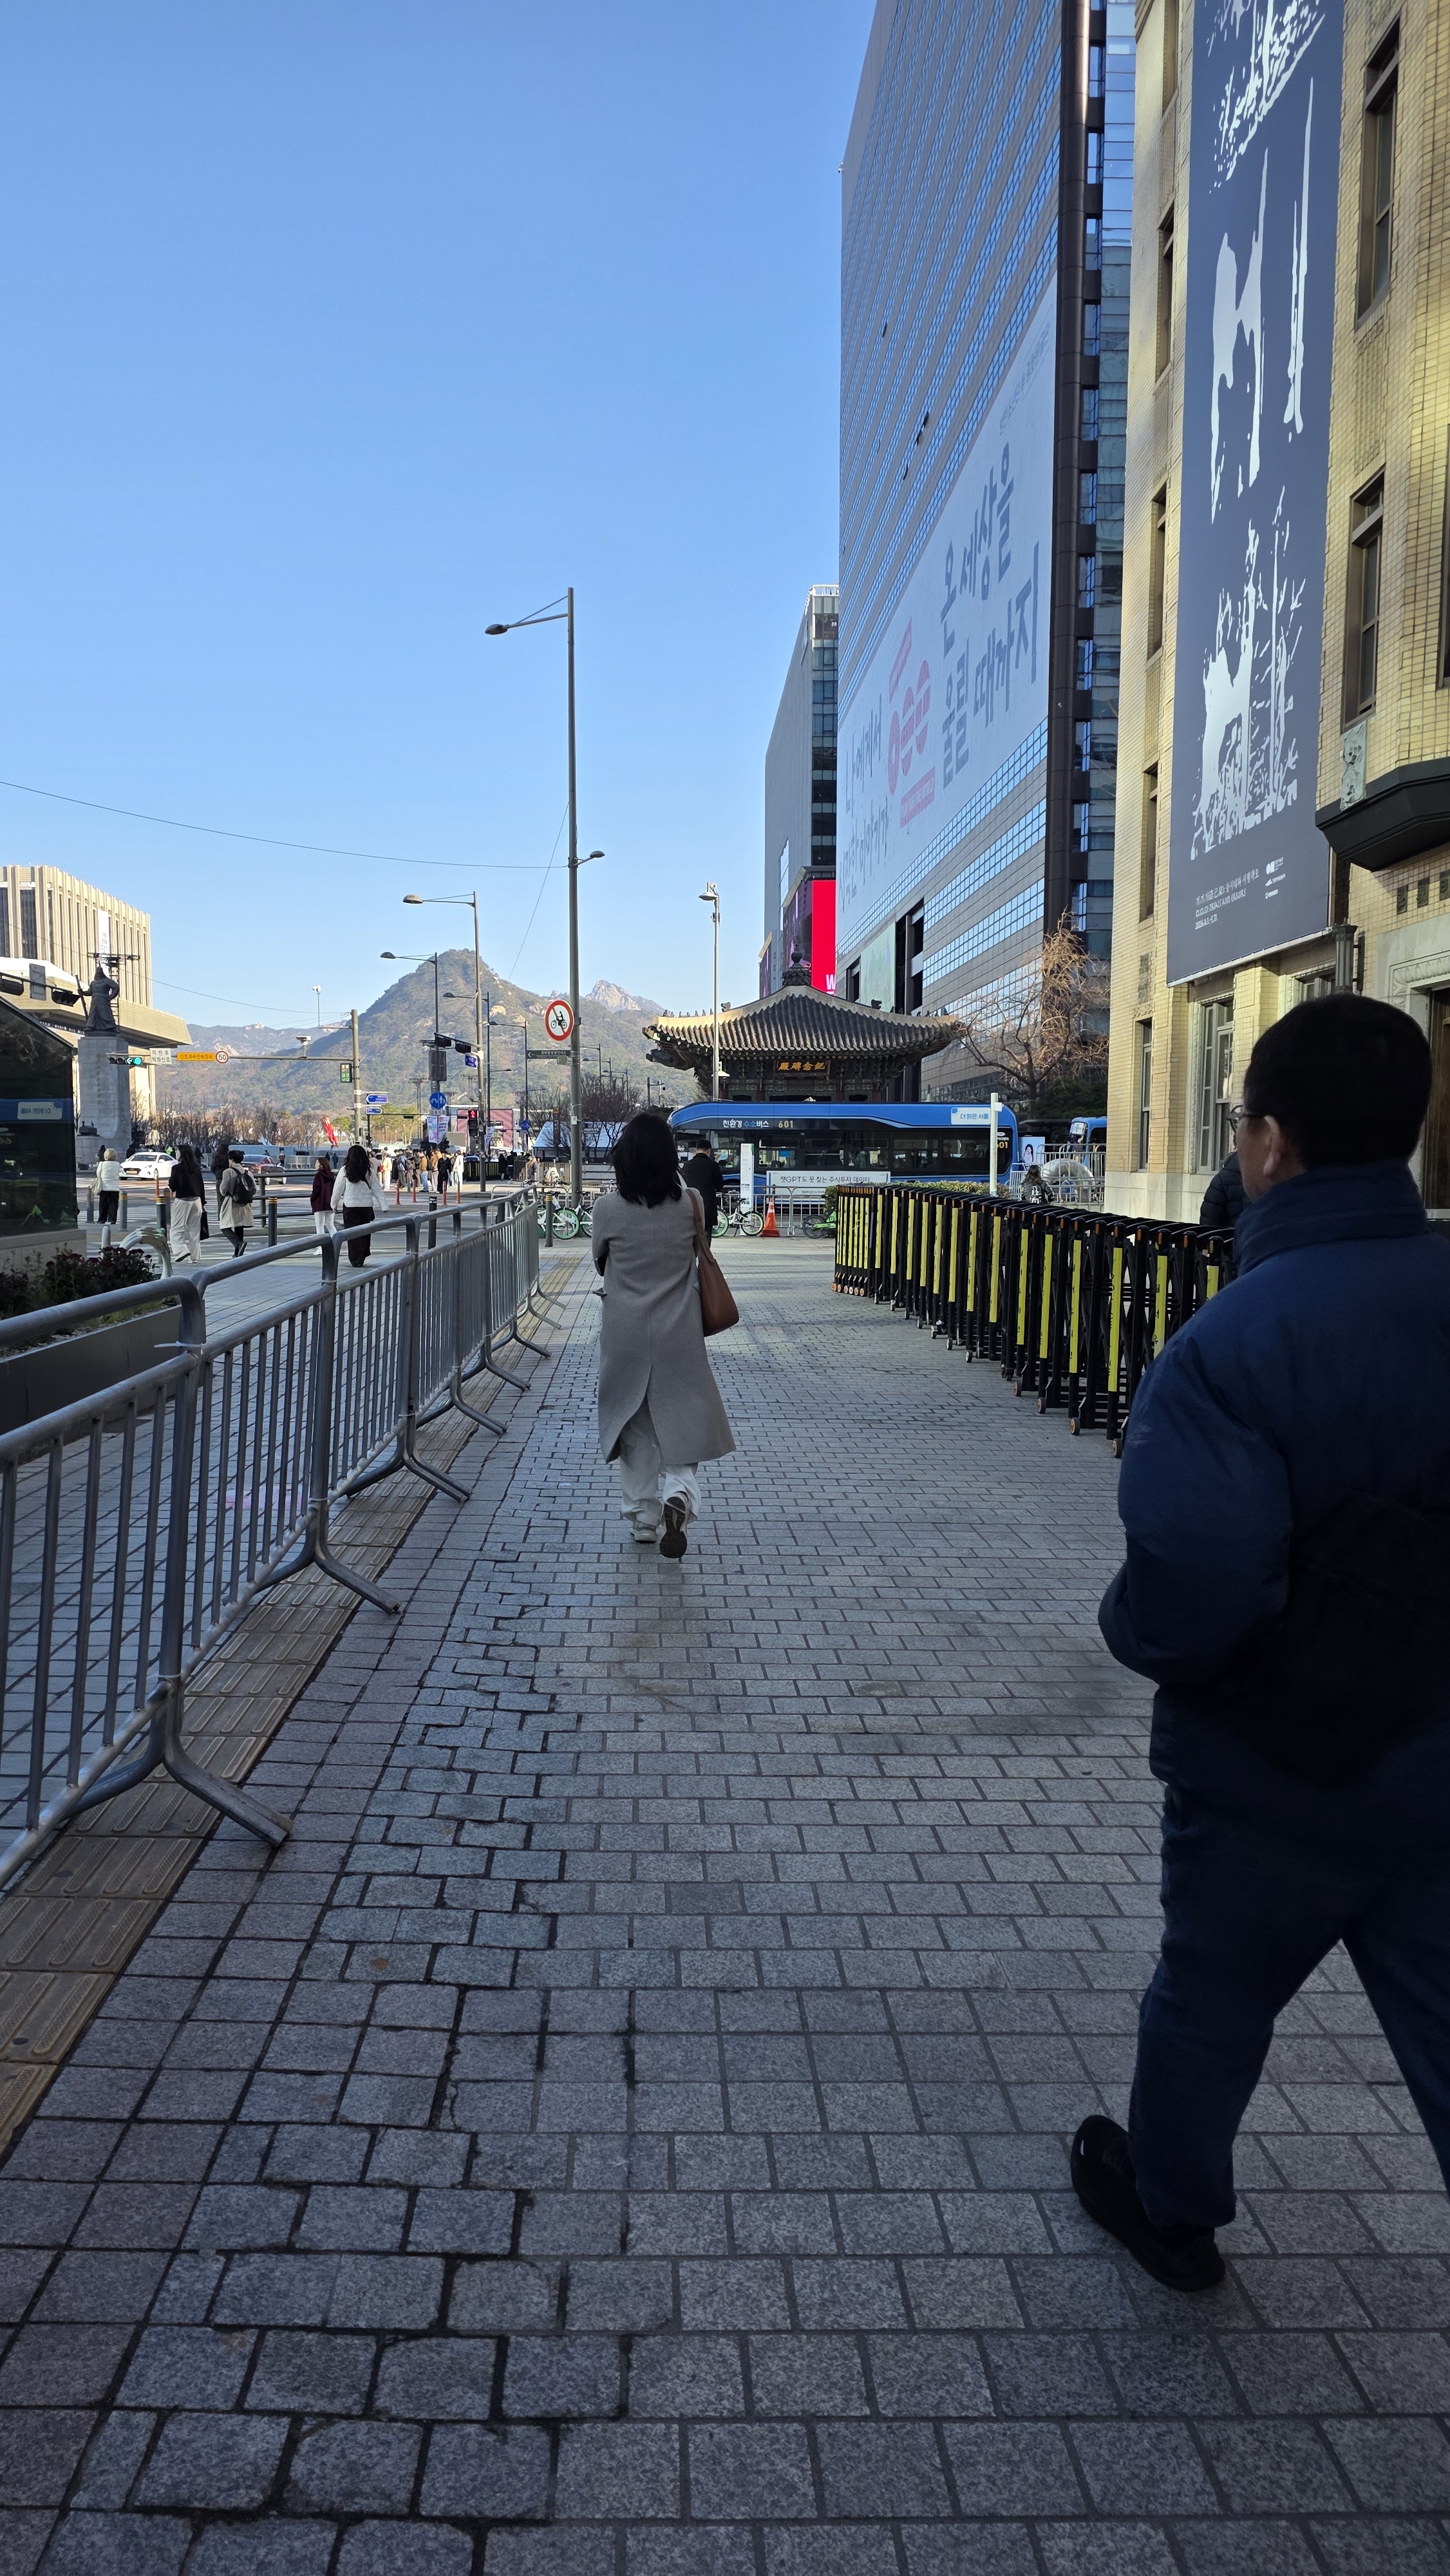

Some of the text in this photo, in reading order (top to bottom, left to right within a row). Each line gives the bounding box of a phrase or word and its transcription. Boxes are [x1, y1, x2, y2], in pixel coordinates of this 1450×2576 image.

[941, 441, 1015, 659] 온 세상을
[943, 540, 1039, 791] 울릴 때까지
[845, 693, 882, 820] 나에게서
[838, 795, 889, 914] 시작한 이야기가
[722, 1119, 769, 1128] 친환경 수소버스
[778, 1120, 793, 1128] 601
